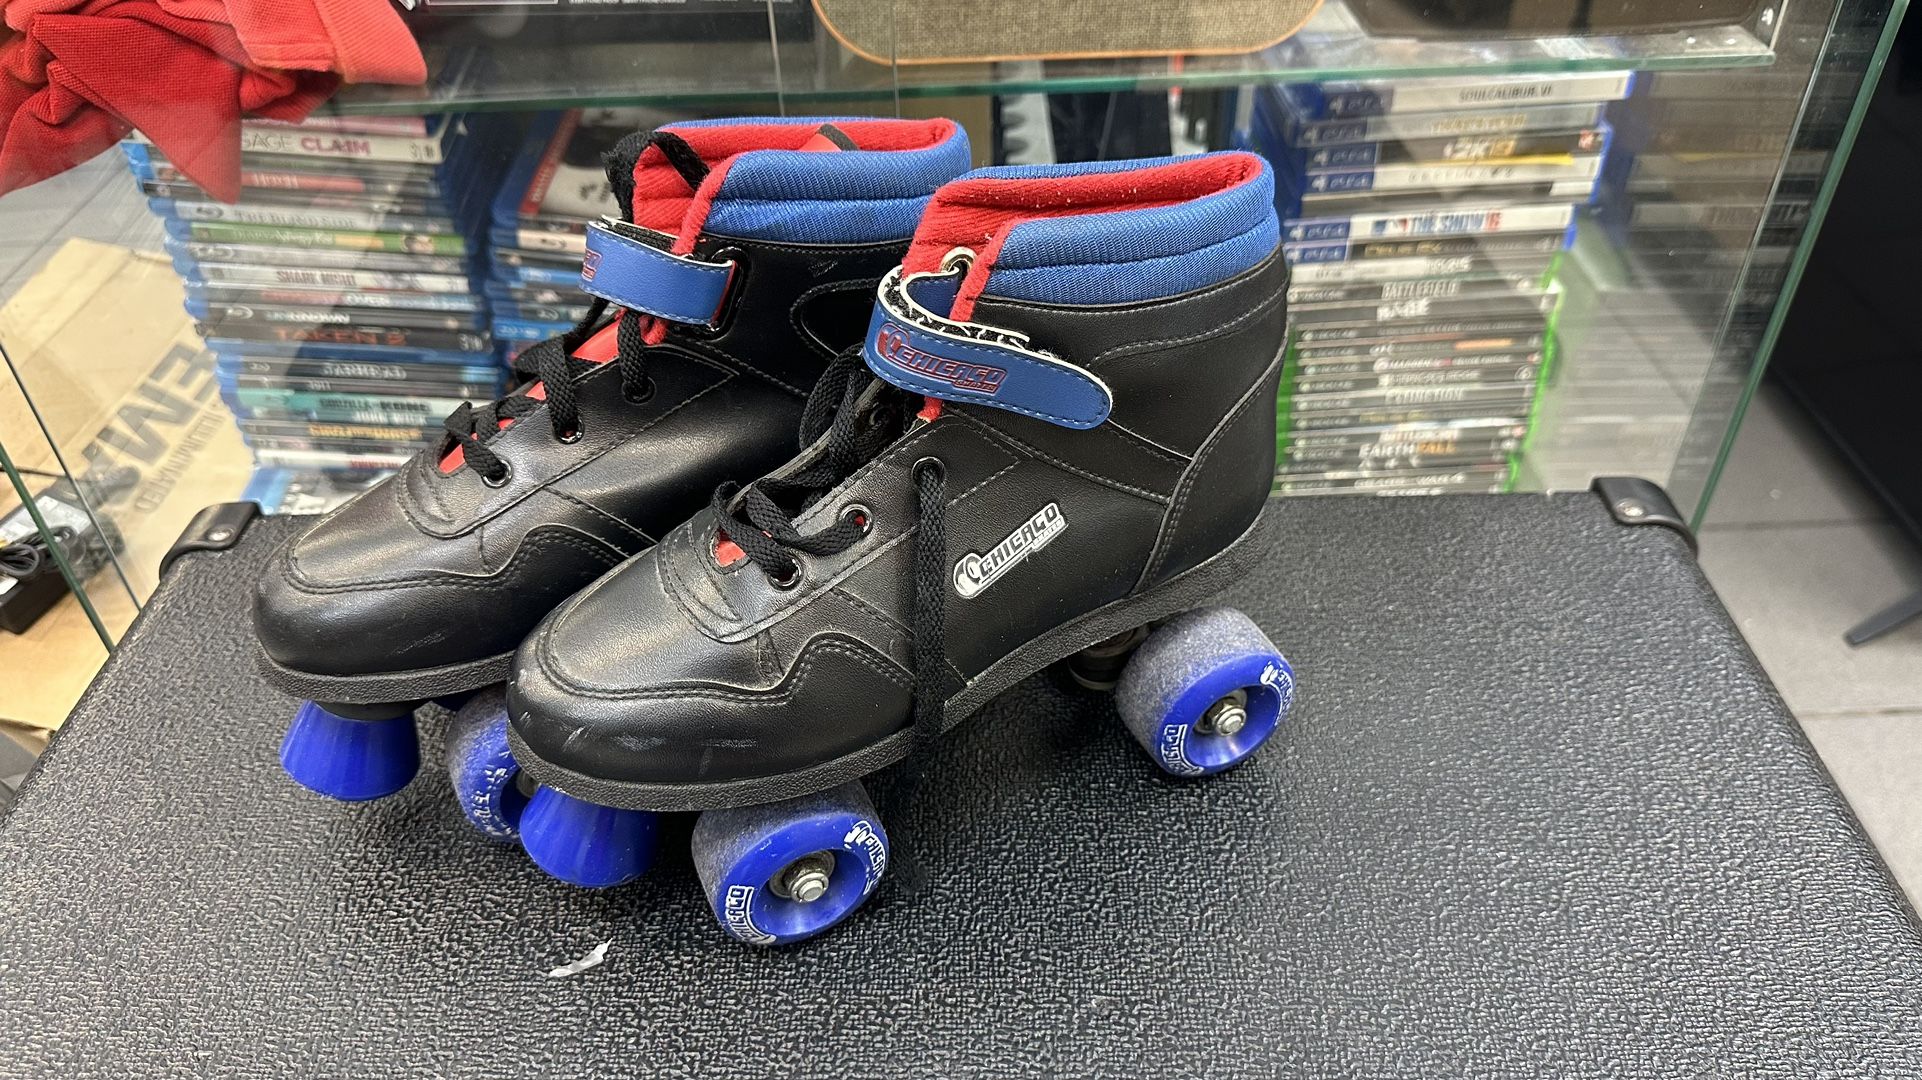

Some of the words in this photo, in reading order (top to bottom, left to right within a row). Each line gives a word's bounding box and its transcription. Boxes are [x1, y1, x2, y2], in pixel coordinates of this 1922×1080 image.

[300, 136, 370, 155] CLAIM
[275, 326, 377, 346] TAKEN
[897, 343, 1007, 385] CHICAGO
[978, 503, 1059, 578] CHICAGO
